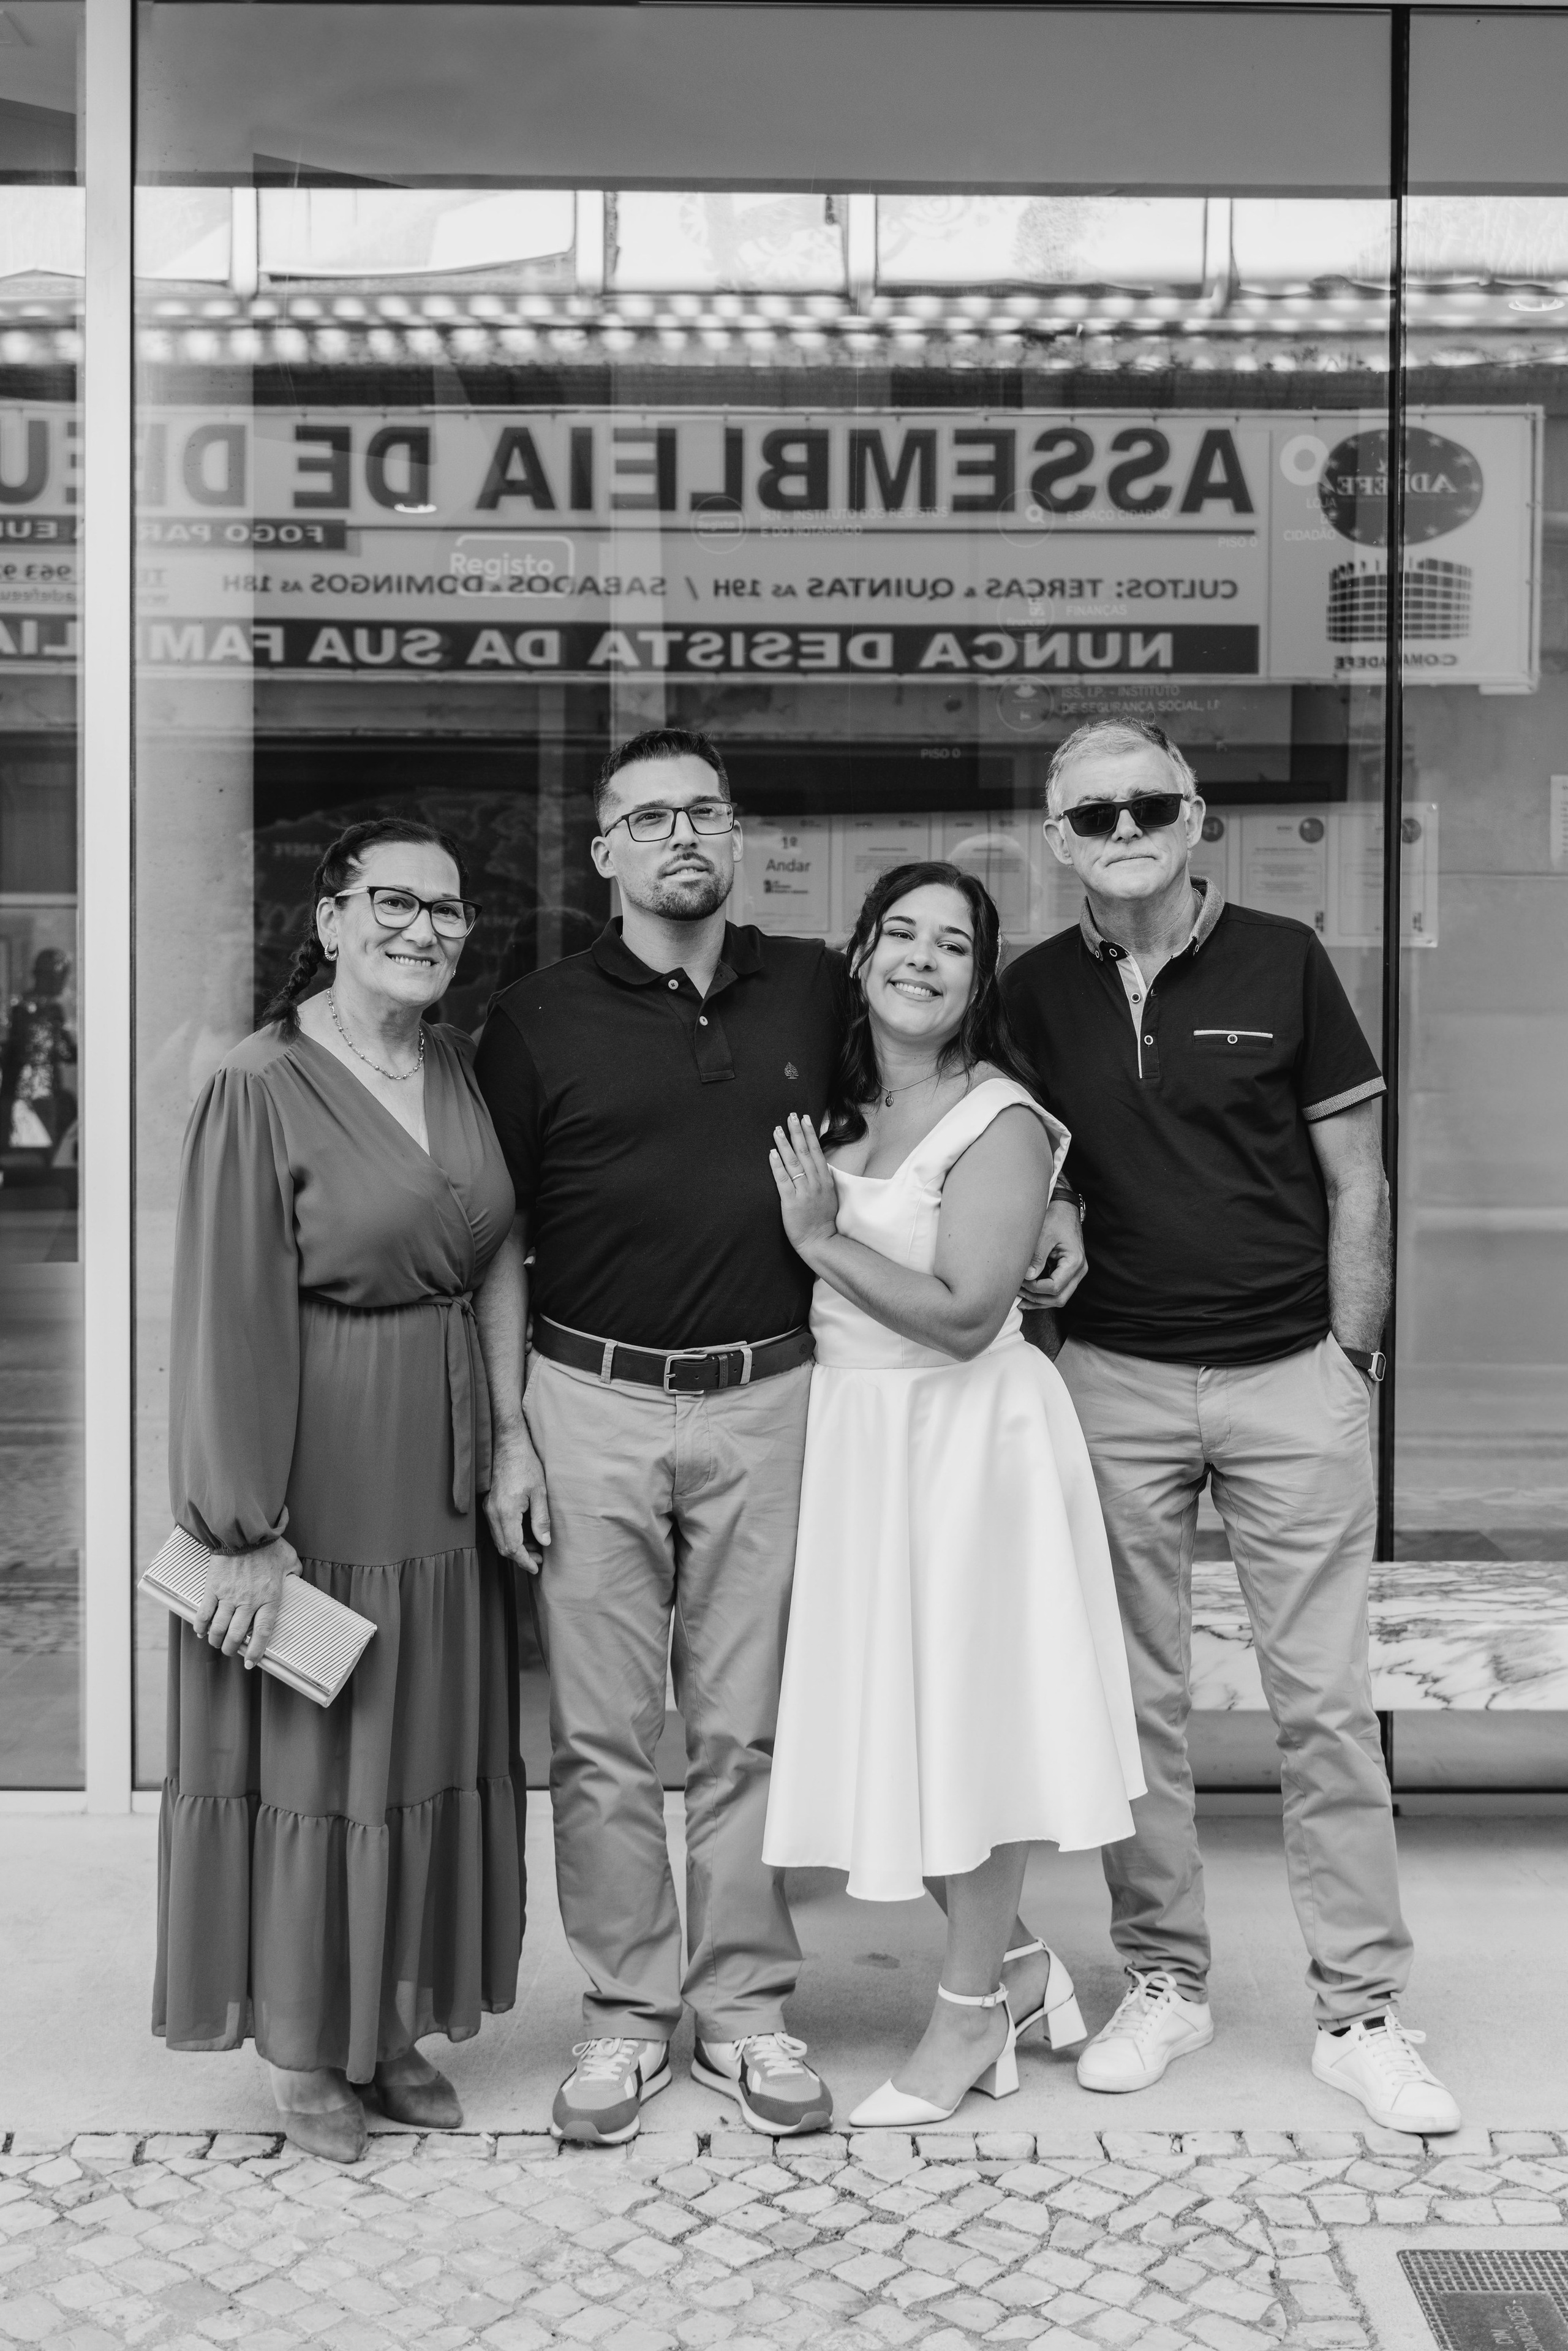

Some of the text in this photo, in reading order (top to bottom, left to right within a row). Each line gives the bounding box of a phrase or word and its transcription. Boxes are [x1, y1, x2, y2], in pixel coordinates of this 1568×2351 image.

[793, 508, 857, 521] INSTITUTO
[1218, 537, 1247, 549] PISO
[449, 552, 556, 581] Registo
[1117, 684, 1181, 697] INSTITUTO
[920, 748, 949, 759] PISO
[765, 859, 812, 873] Andar
